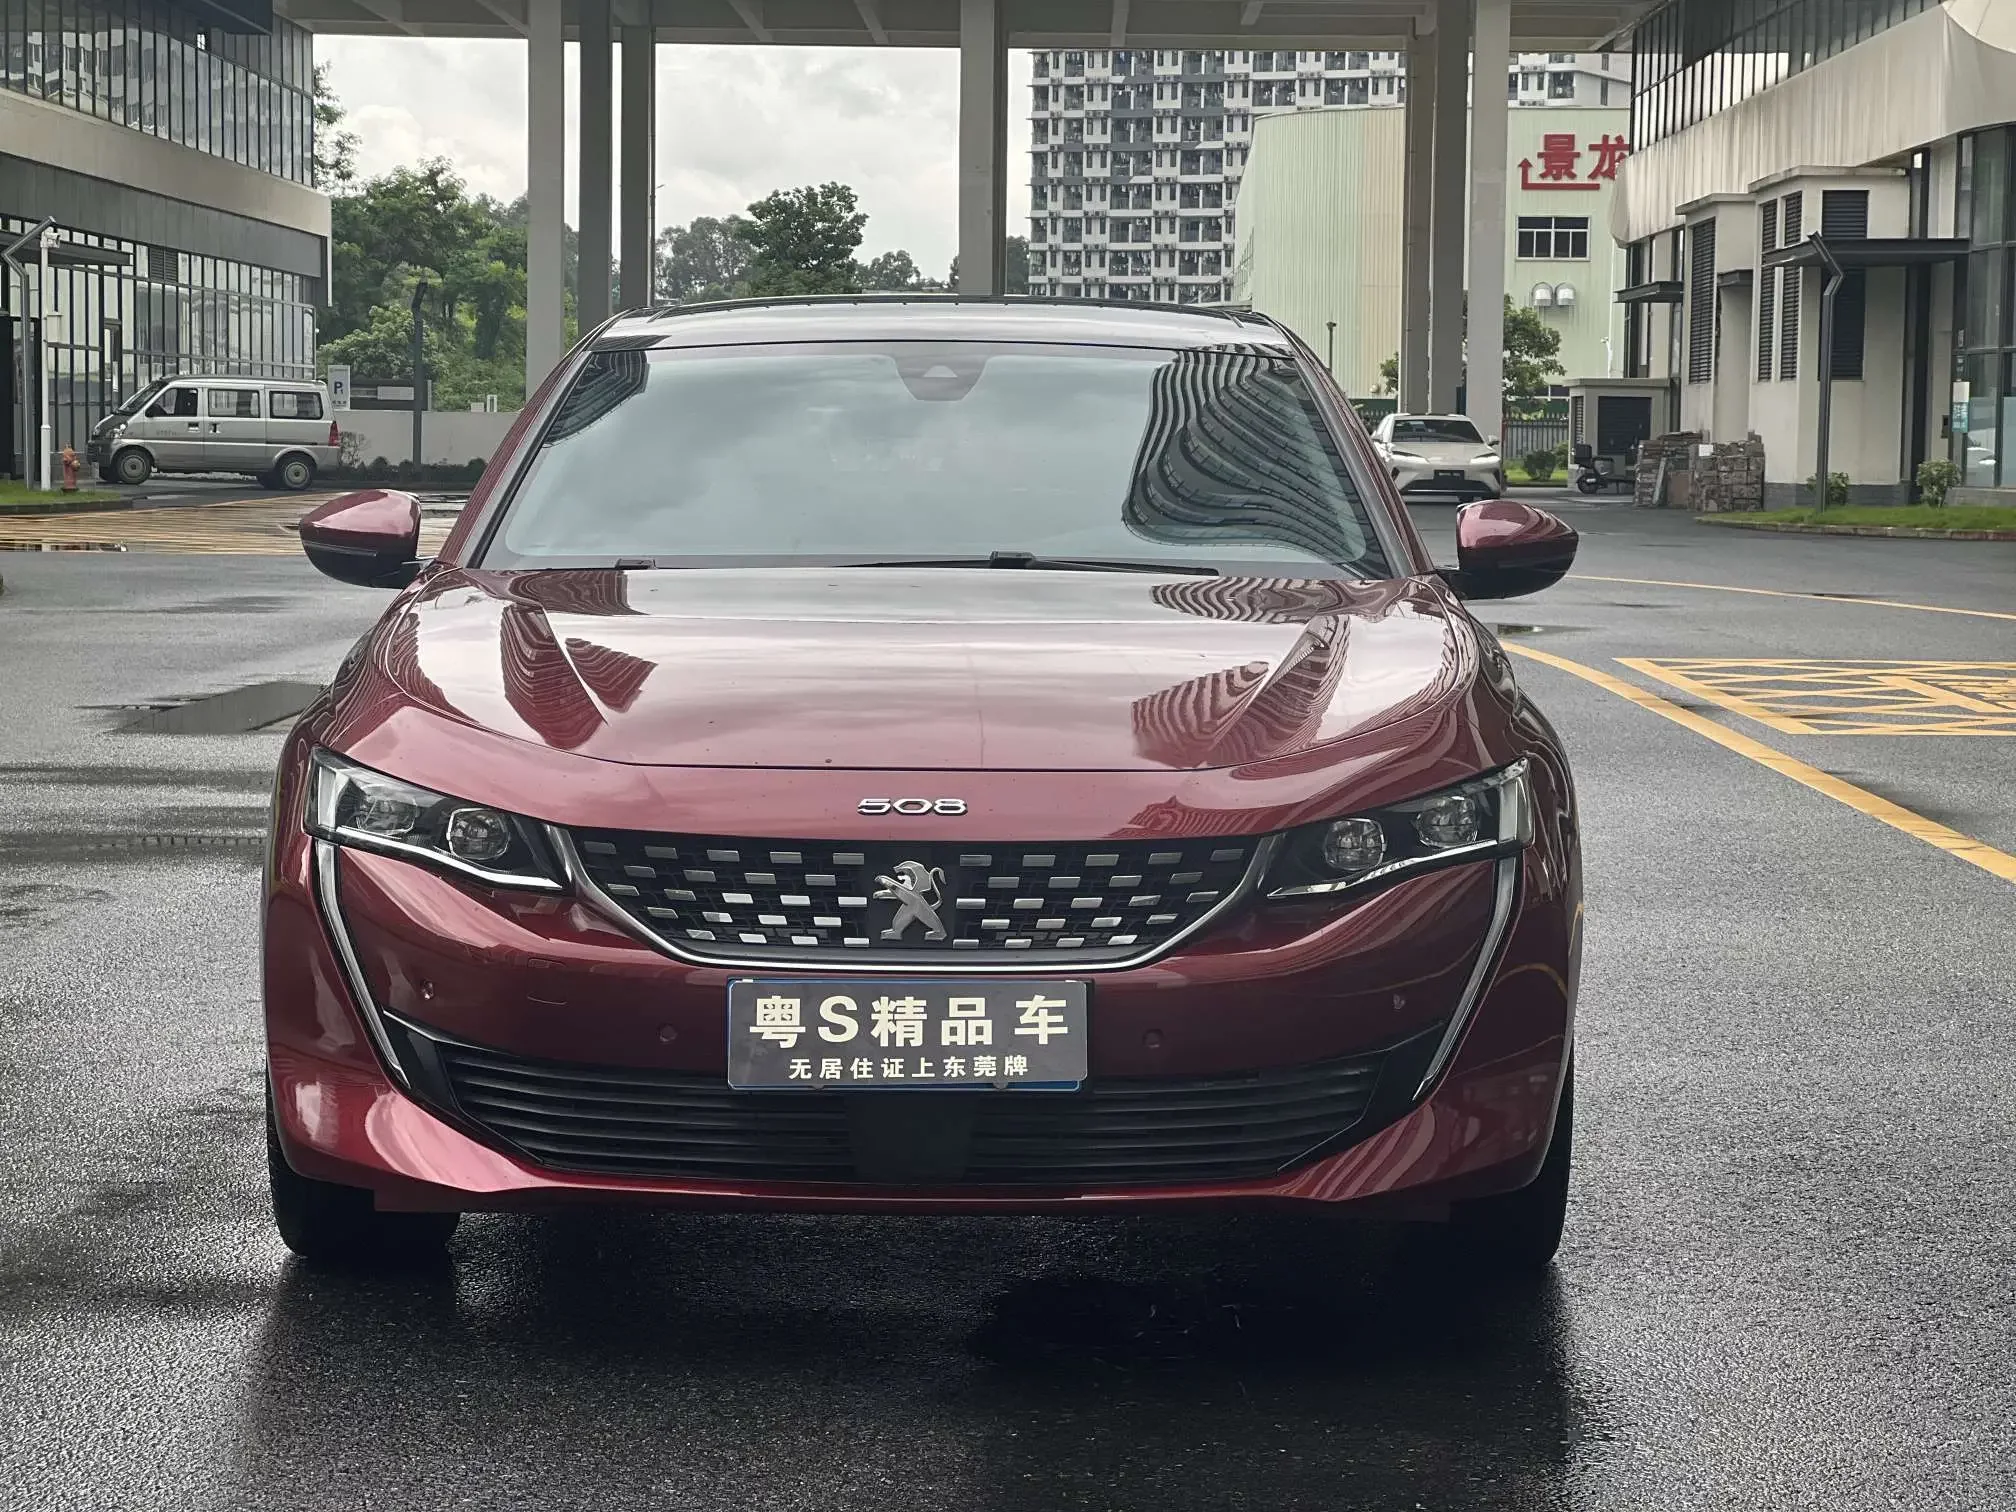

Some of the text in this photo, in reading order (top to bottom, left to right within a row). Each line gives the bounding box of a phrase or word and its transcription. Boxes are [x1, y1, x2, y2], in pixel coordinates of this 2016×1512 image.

[1537, 133, 1631, 180] 景龙
[857, 797, 968, 816] 508
[749, 994, 1069, 1048] 粤S精品车
[788, 1054, 1029, 1080] 无居住证上东莞牌
